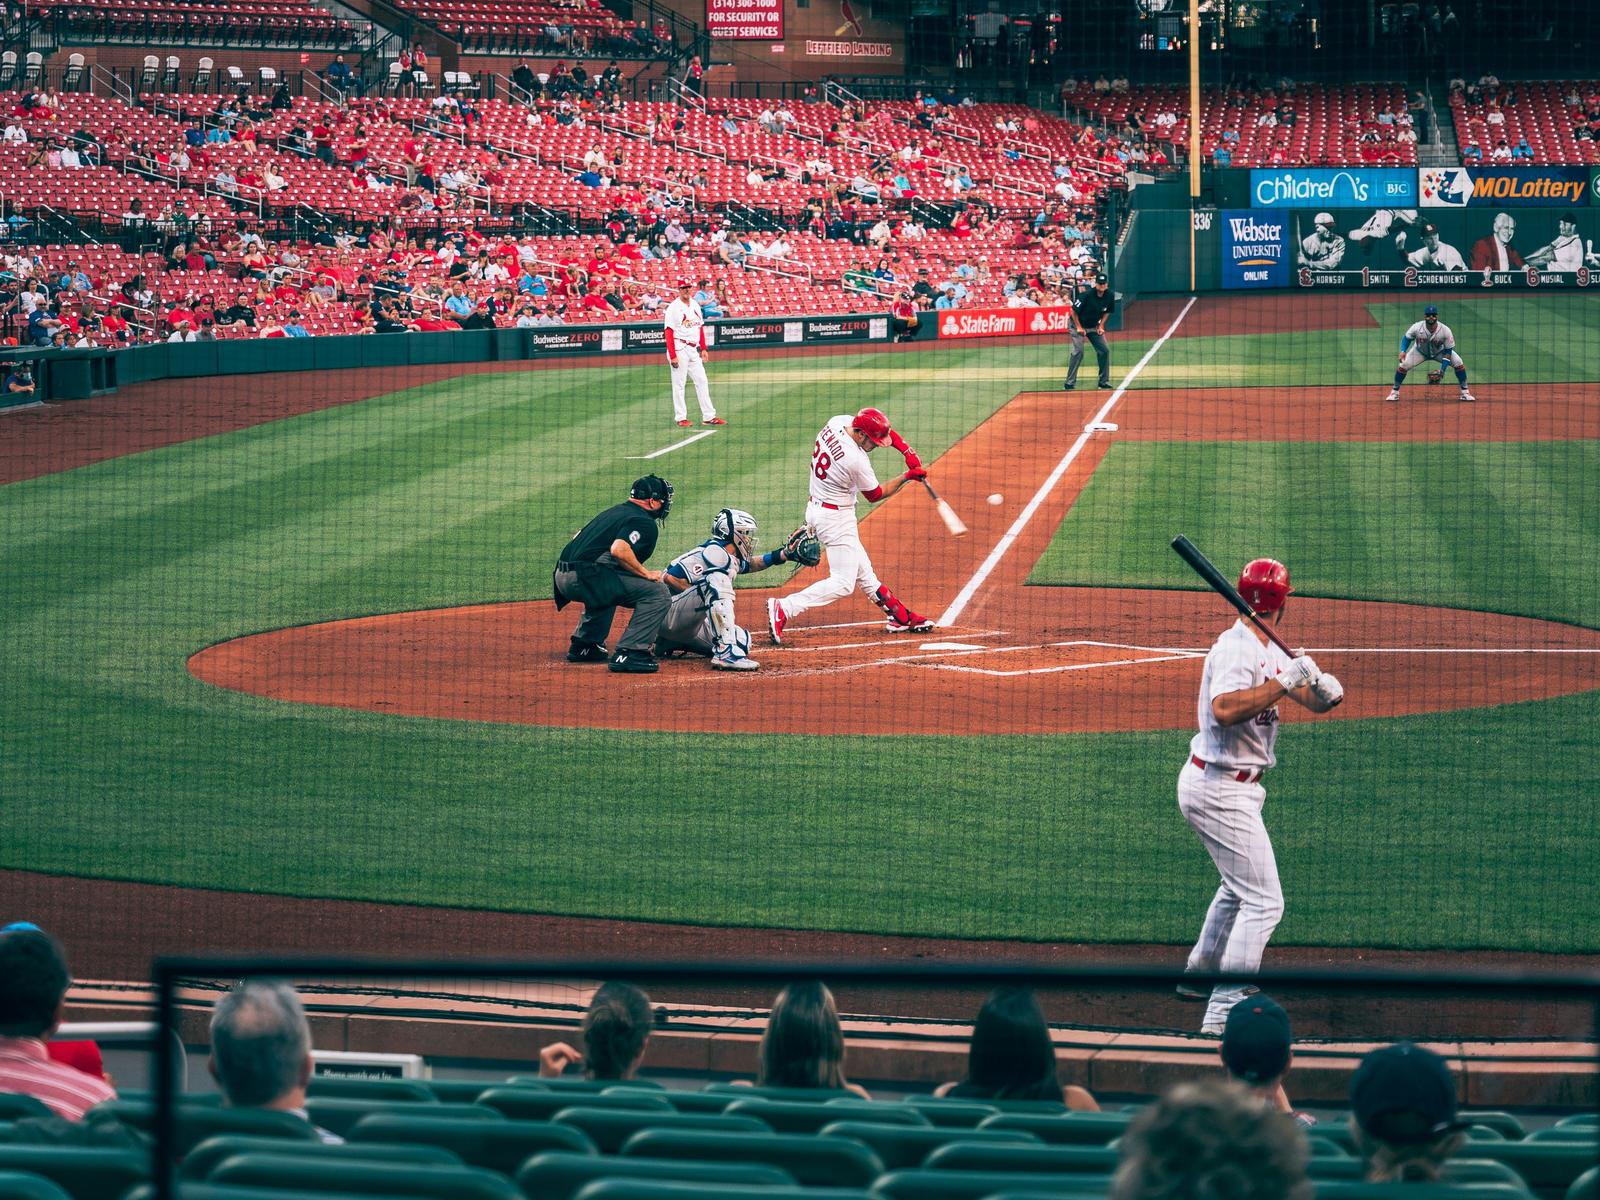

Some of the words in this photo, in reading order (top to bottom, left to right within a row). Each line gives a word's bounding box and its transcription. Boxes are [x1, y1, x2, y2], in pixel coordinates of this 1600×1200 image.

[708, 12, 725, 22] FOR
[726, 12, 767, 23] SECURITY
[768, 12, 779, 22] OR
[712, 27, 738, 37] GUEST
[739, 27, 778, 37] SERVICES
[1387, 183, 1407, 194] BJC
[1472, 177, 1585, 202] MOLottery
[1229, 216, 1281, 242] Webster
[1232, 244, 1281, 259] UNIVERSITY
[1243, 270, 1269, 281] ONLINE
[1370, 275, 1389, 284] SMITH
[1404, 266, 1418, 287] 2
[1494, 274, 1512, 283] BUCK
[1541, 274, 1564, 283] MUSIAL
[1576, 266, 1590, 287] 9
[721, 325, 754, 335] Budweiser
[755, 324, 783, 334] ZERO
[809, 322, 841, 332] Budweiser
[842, 321, 868, 330] ZERO
[533, 334, 569, 344] Budweiser
[570, 332, 600, 342] ZERO
[629, 329, 664, 340] Budweiser
